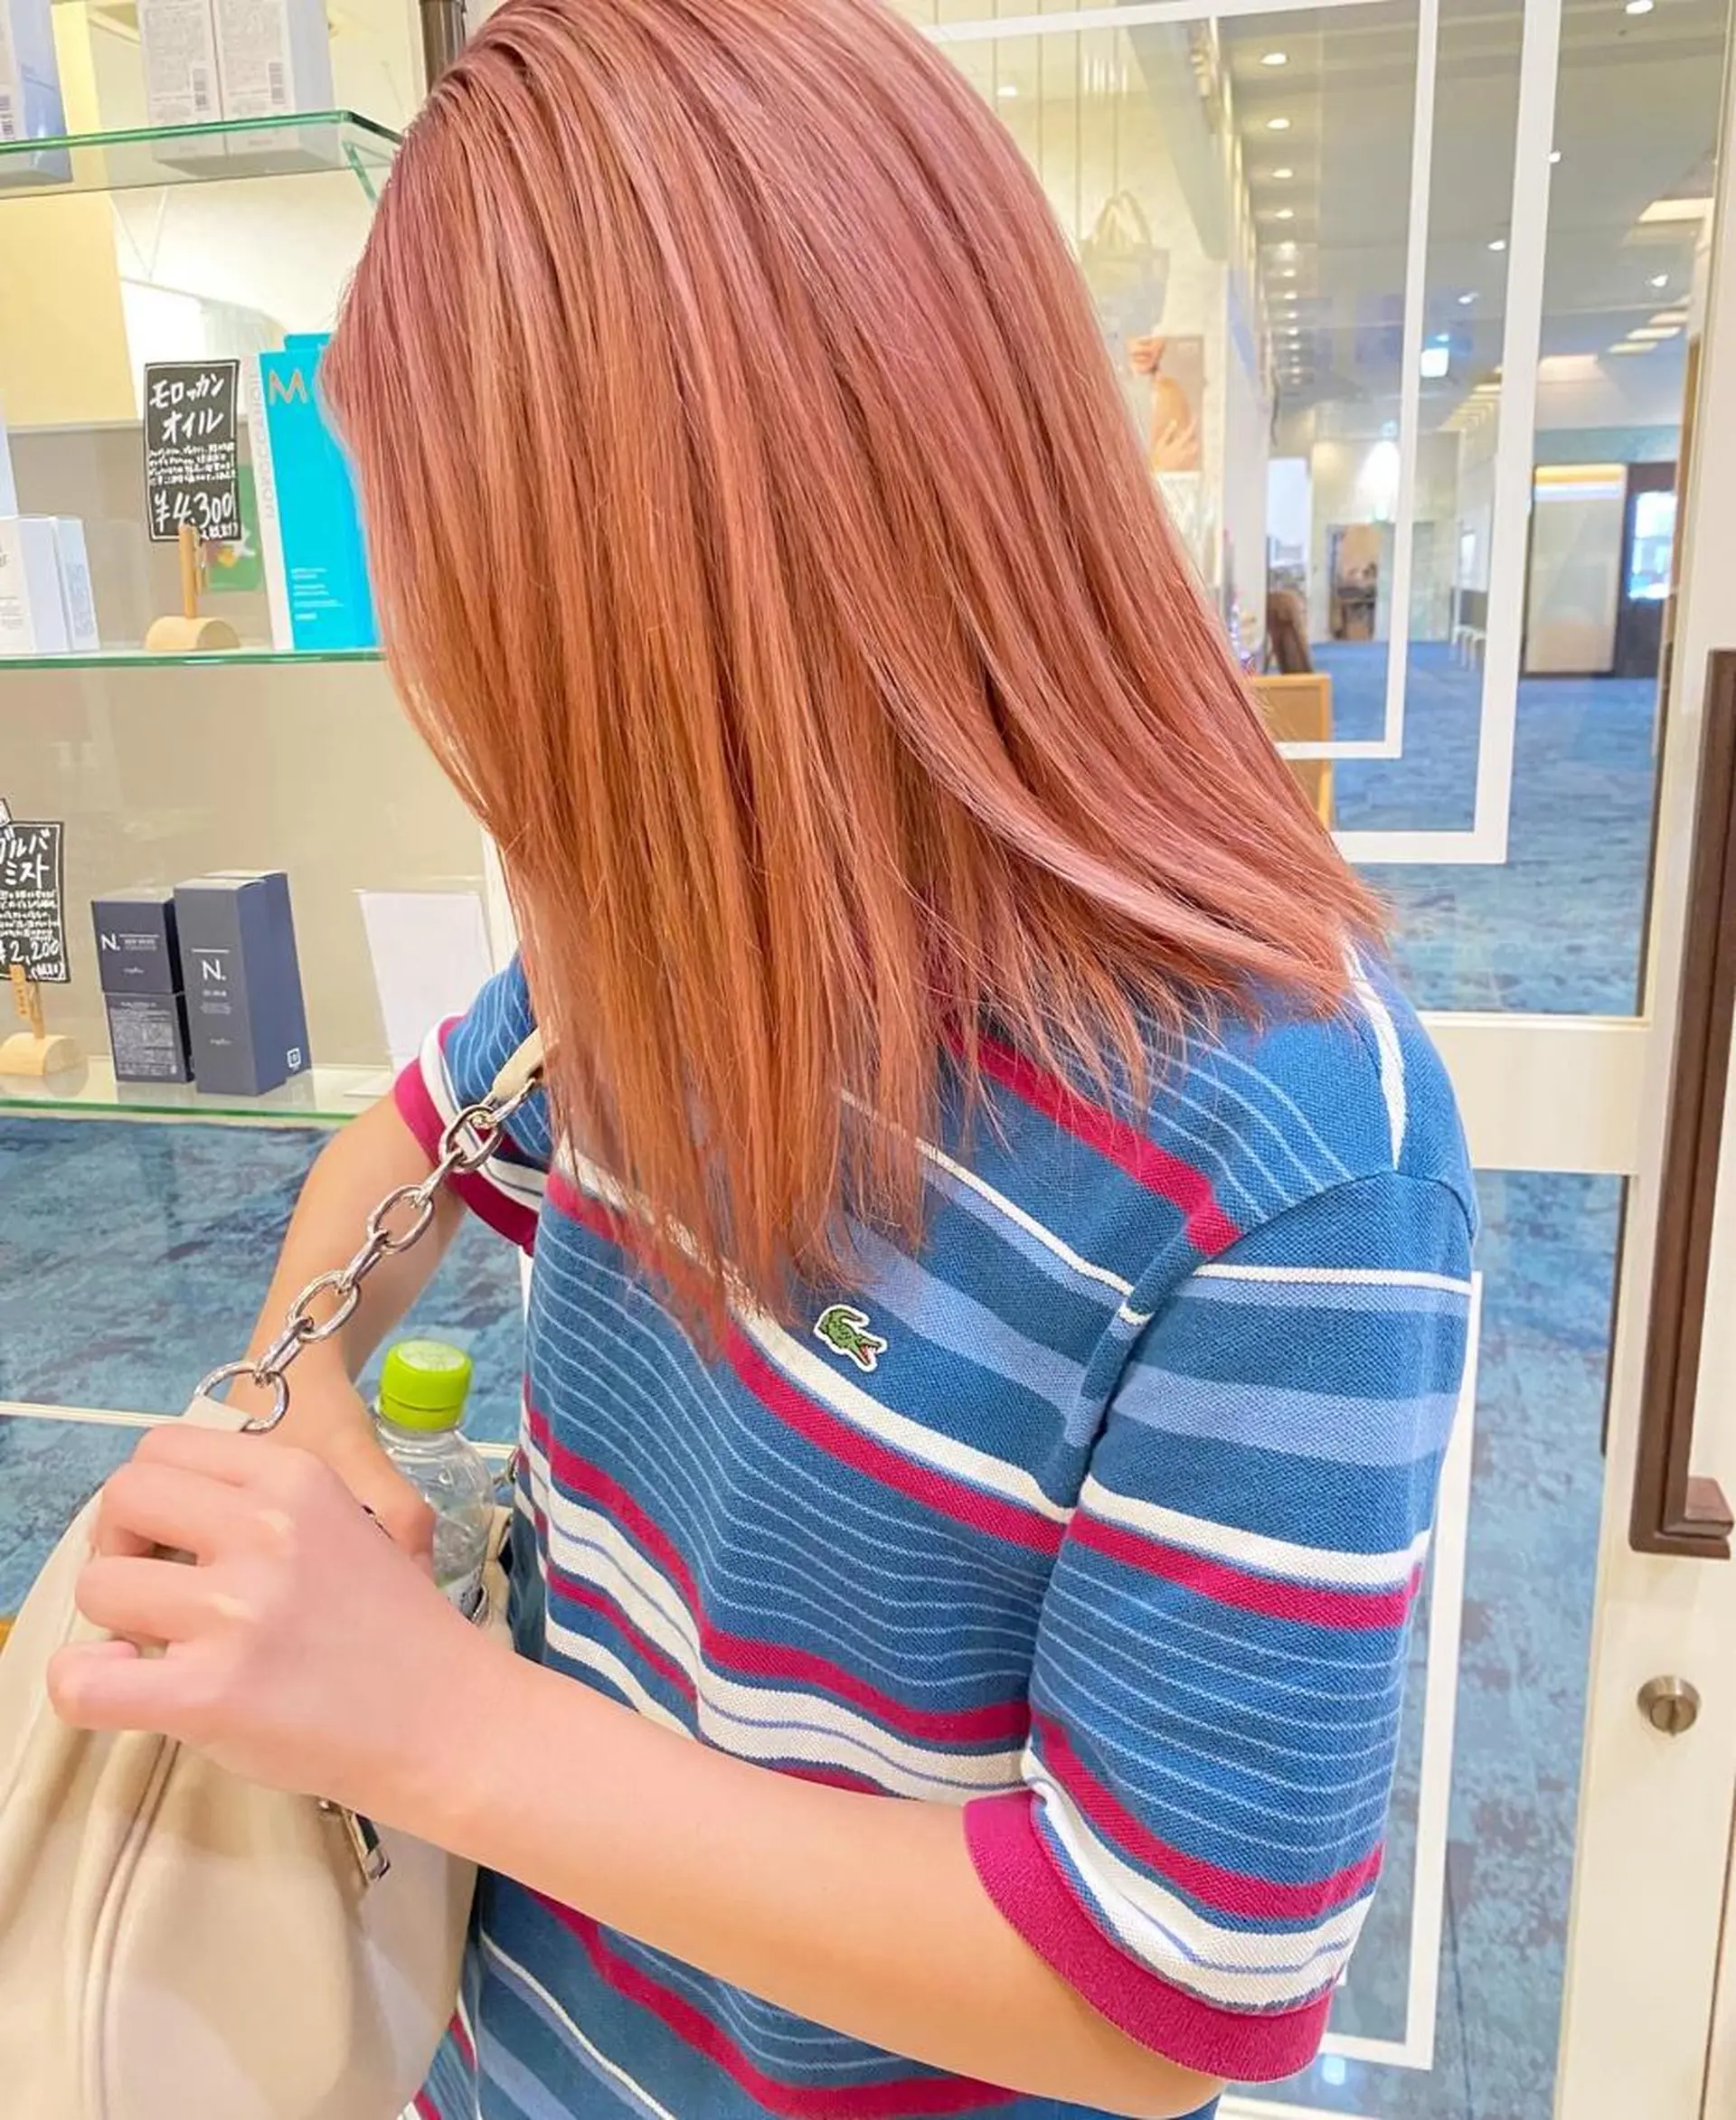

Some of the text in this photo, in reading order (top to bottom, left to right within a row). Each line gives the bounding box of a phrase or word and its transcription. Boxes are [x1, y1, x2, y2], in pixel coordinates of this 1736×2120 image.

[149, 372, 224, 409] モロッカン
[162, 408, 224, 445] オイル
[5, 853, 50, 890] ミスト
[100, 932, 121, 952] N.
[202, 958, 228, 981] N.
